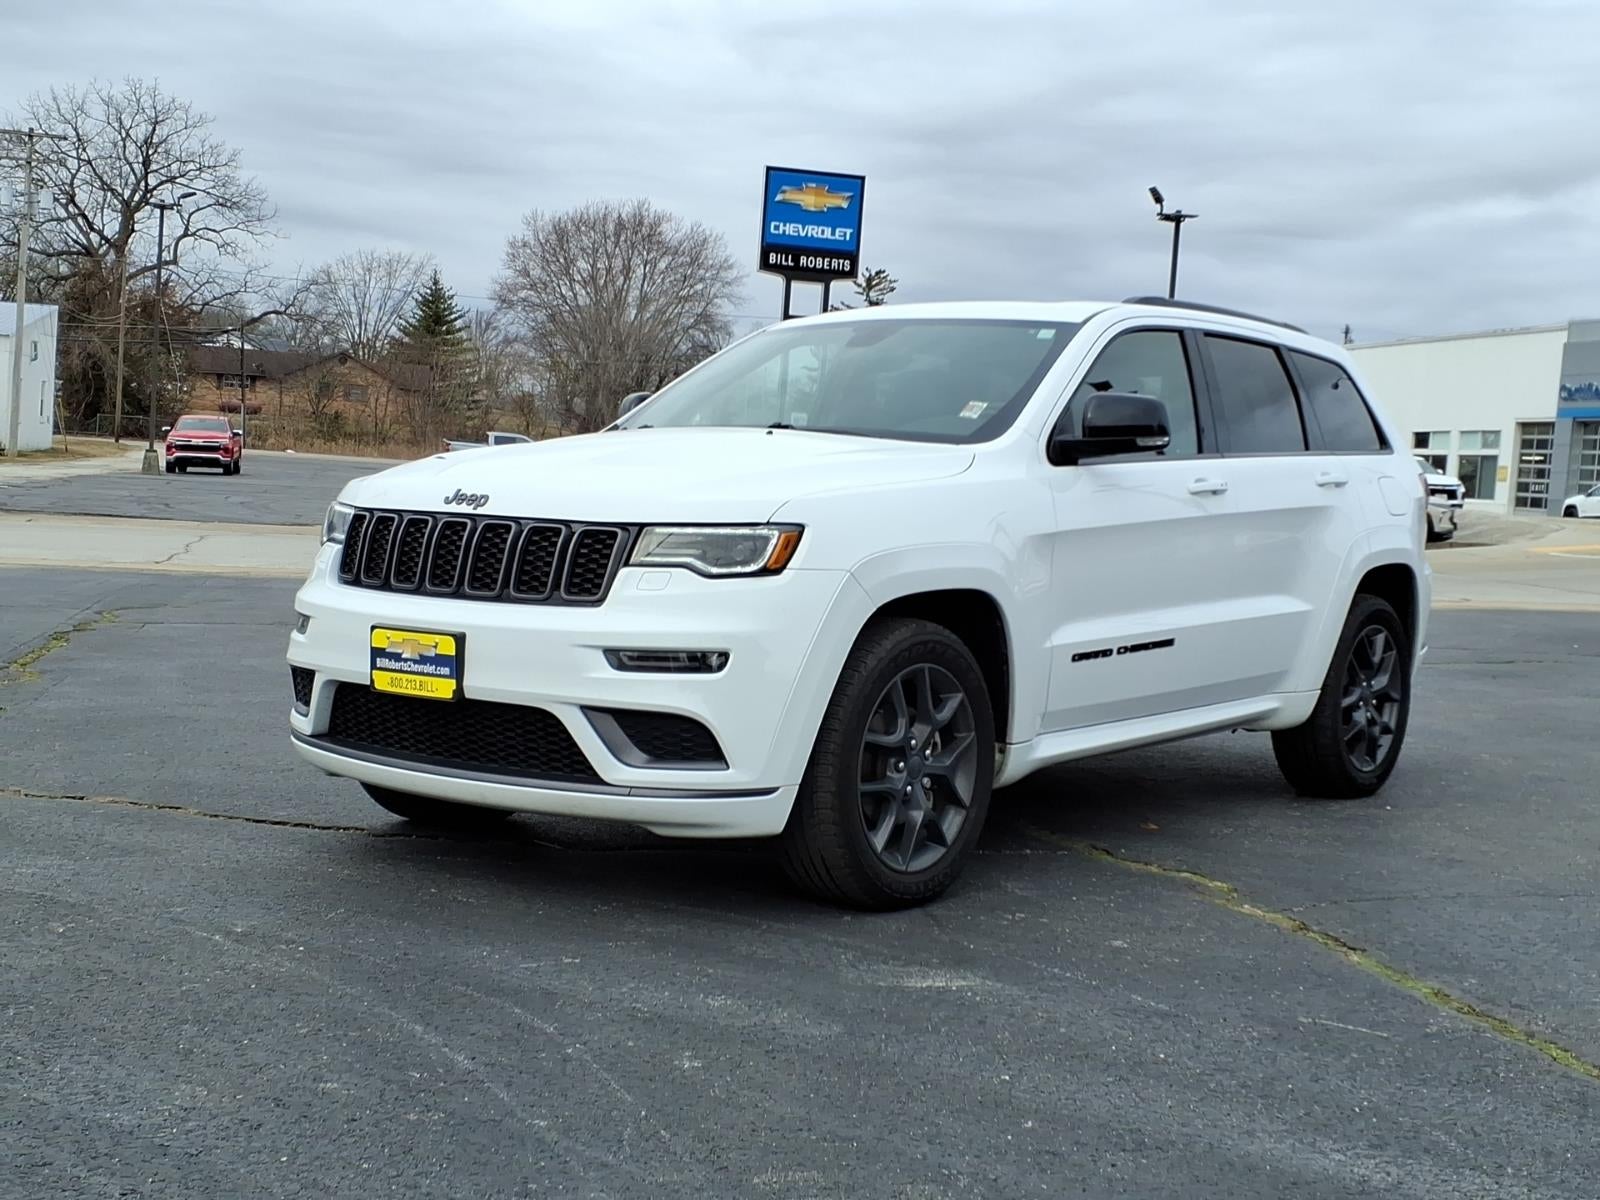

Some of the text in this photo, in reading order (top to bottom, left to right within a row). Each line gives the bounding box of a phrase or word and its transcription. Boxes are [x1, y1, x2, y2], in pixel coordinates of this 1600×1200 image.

[770, 221, 853, 240] CHEVROLET
[769, 252, 851, 271] BILL ROBERTS
[444, 488, 490, 510] Jeep
[376, 658, 450, 675] BillRobertsChevrolet.com
